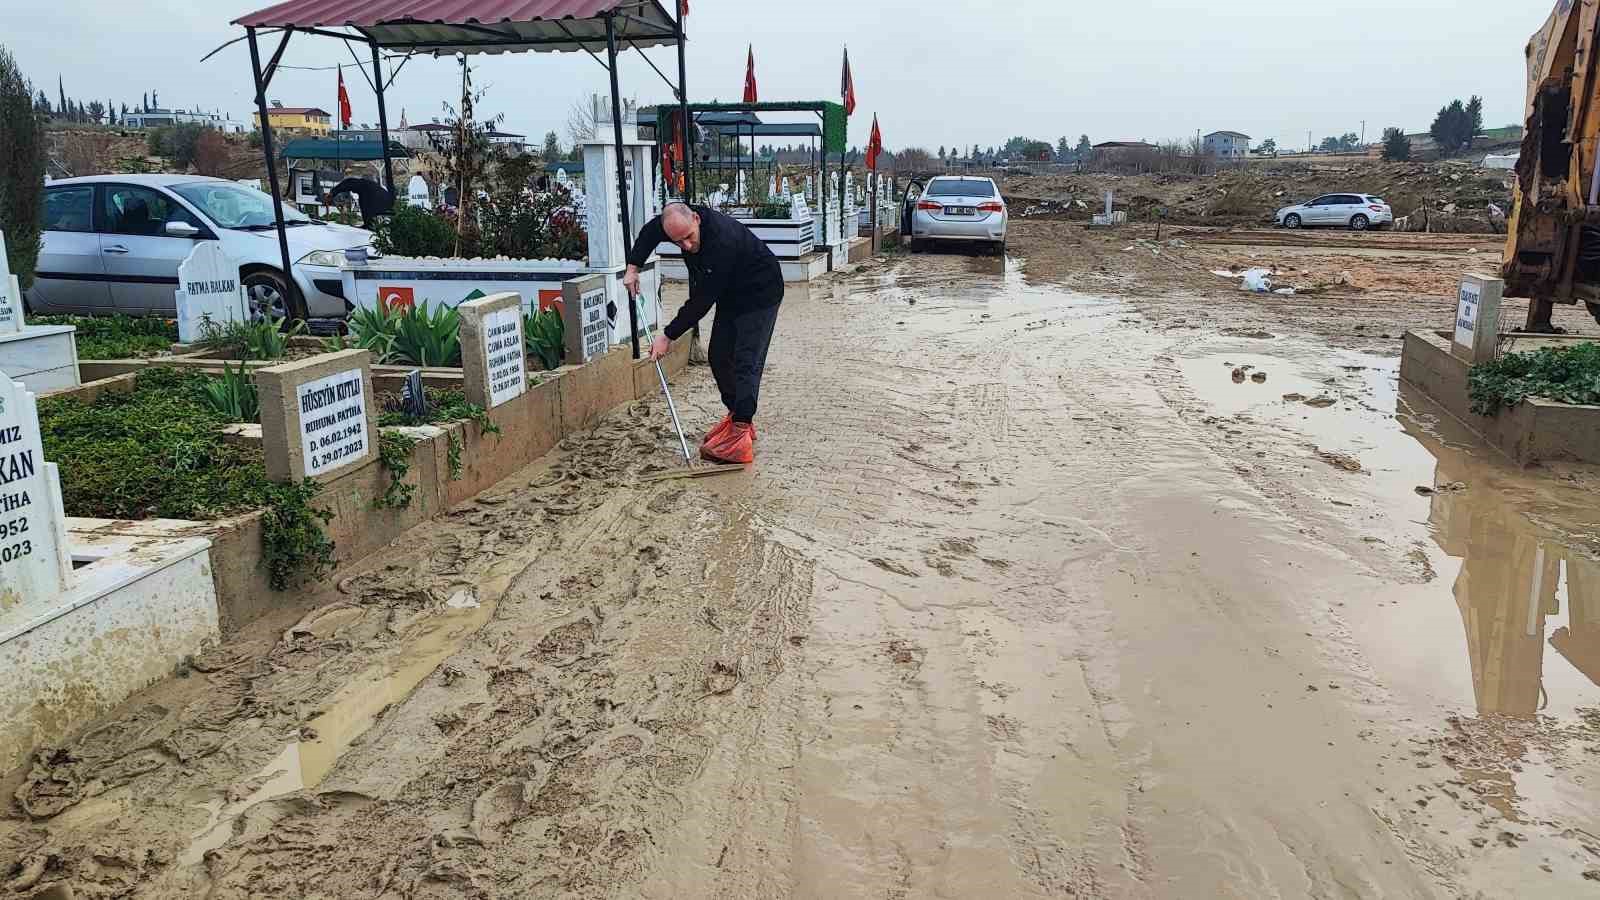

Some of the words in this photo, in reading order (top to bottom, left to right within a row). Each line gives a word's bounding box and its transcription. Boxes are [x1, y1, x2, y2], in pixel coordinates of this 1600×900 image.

[187, 281, 209, 295] FATMA
[210, 280, 235, 294] BALKAN
[301, 383, 336, 413] HÜSEYİN
[336, 378, 360, 402] KUTLU
[305, 414, 337, 433] RUHUNA
[310, 441, 318, 452] D.
[320, 423, 362, 448] 06.02.1942
[321, 439, 363, 465] 29.07.2023
[0, 490, 32, 514] İHA
